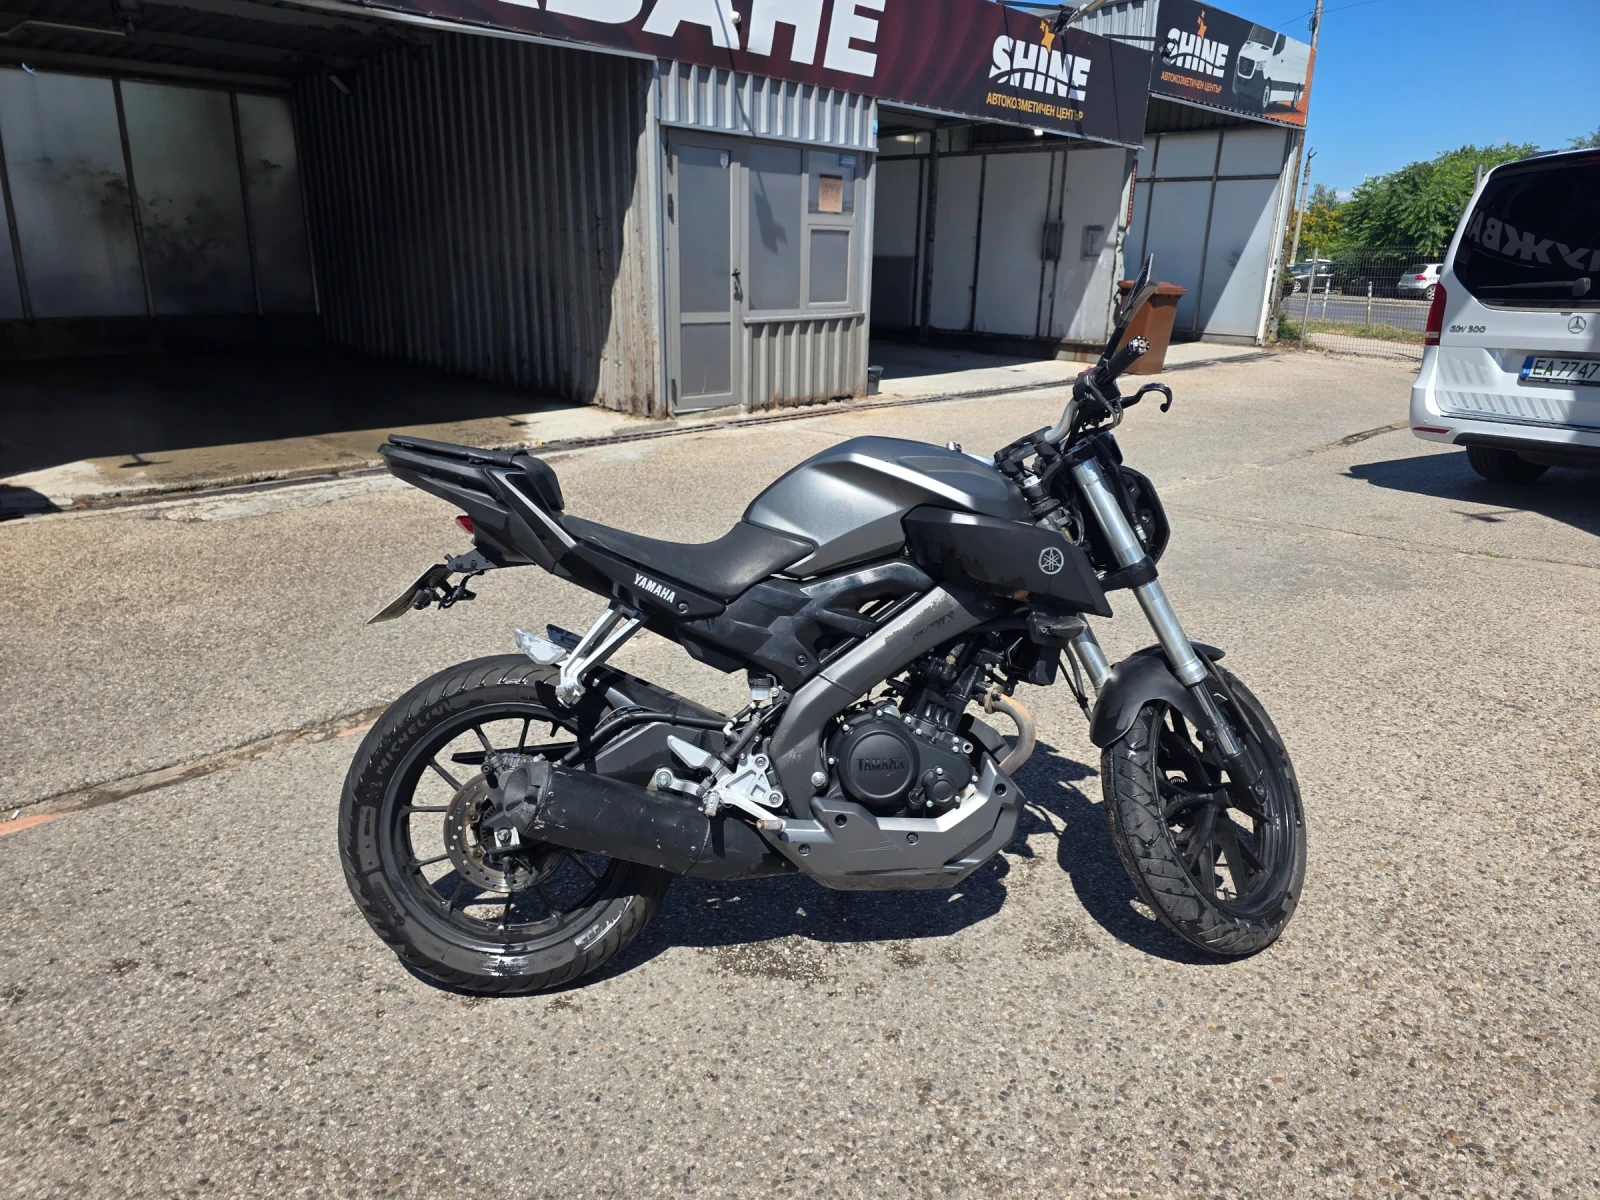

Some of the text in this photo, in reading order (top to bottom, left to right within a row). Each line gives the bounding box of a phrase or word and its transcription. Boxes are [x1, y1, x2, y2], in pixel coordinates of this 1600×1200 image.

[989, 35, 1091, 101] SHINE
[1167, 28, 1229, 78] SHINE
[986, 92, 1084, 121] АВТОКОЗМЕТИЧЕН ЦЕНТЪР
[1532, 360, 1554, 376] EA
[633, 572, 676, 603] YAMAHA
[376, 699, 453, 775] MICHELIN
[857, 758, 904, 772] YAMAHA
